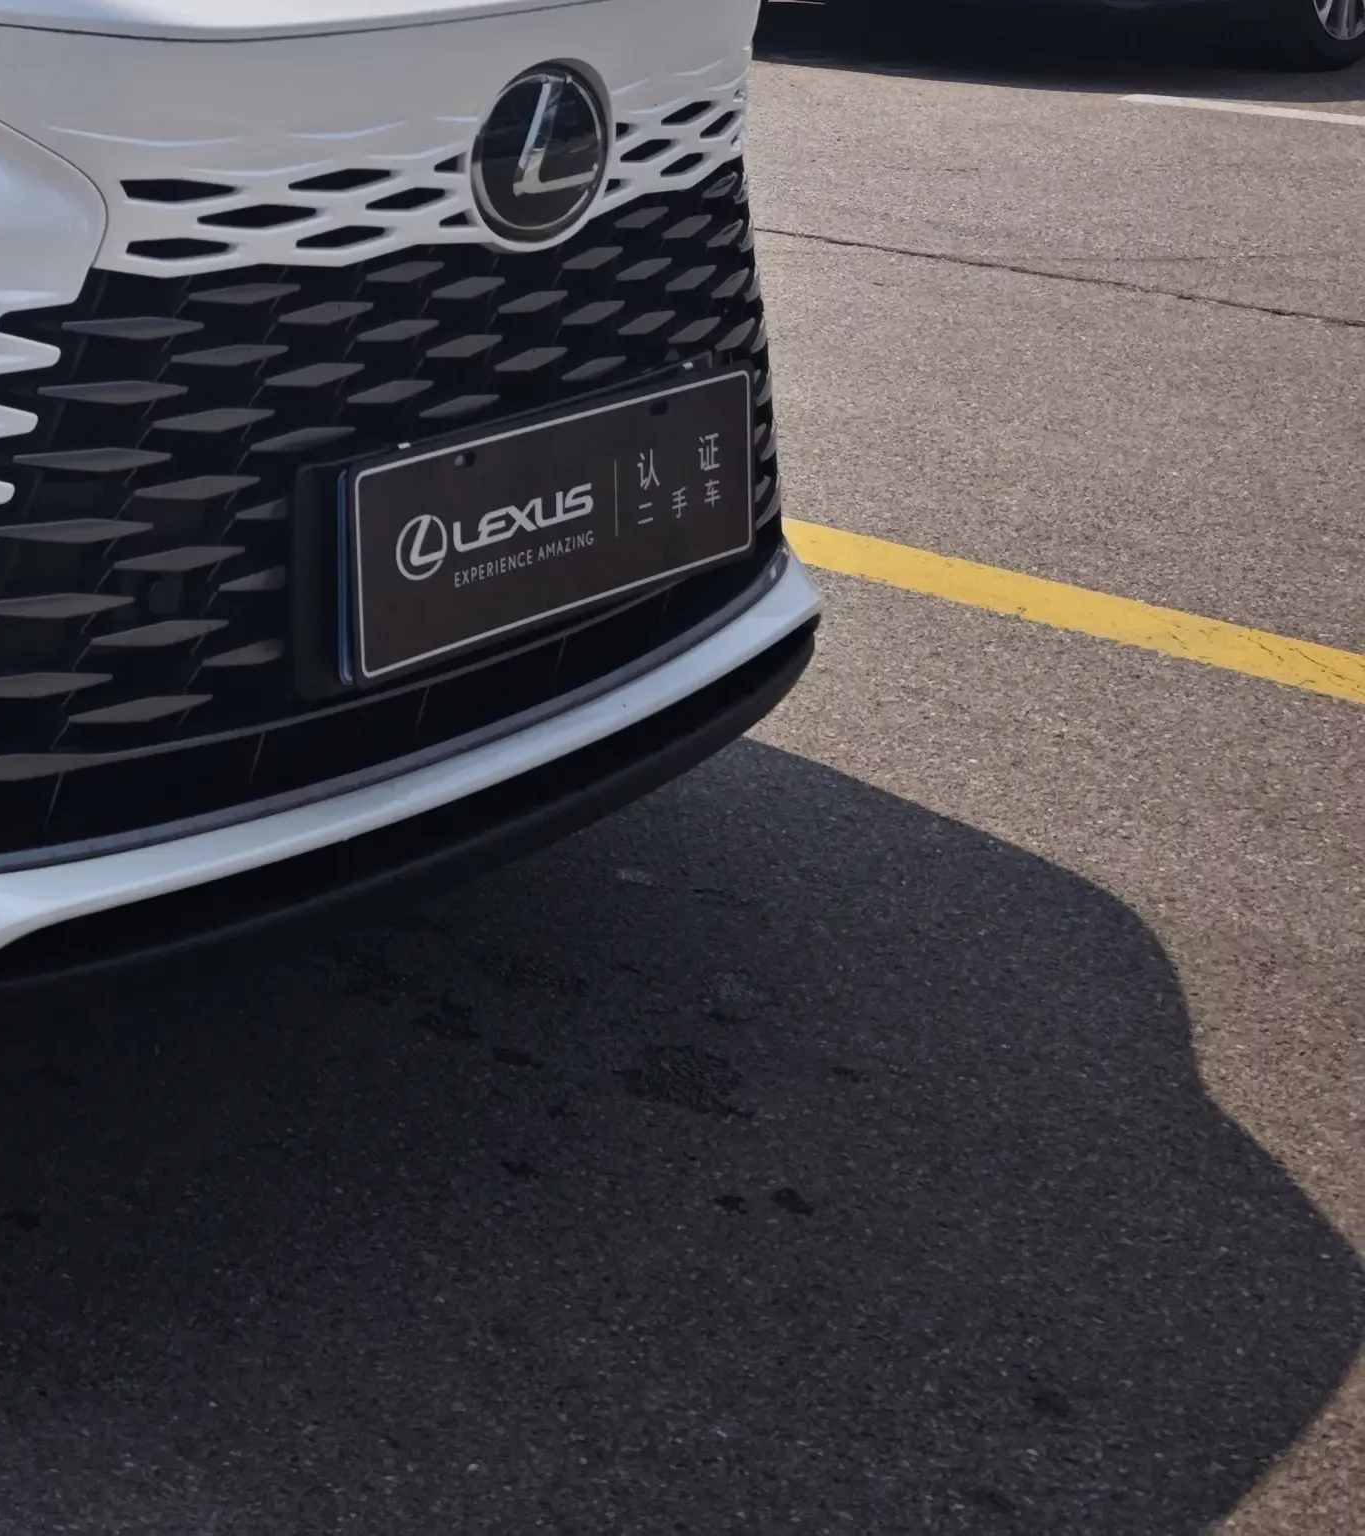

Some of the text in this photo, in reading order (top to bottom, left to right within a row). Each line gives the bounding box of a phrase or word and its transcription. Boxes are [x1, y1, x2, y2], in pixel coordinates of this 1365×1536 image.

[453, 483, 594, 553] LEXUS
[637, 479, 722, 525] 二手车
[454, 530, 595, 588] EXPERIENCE AMAZING
